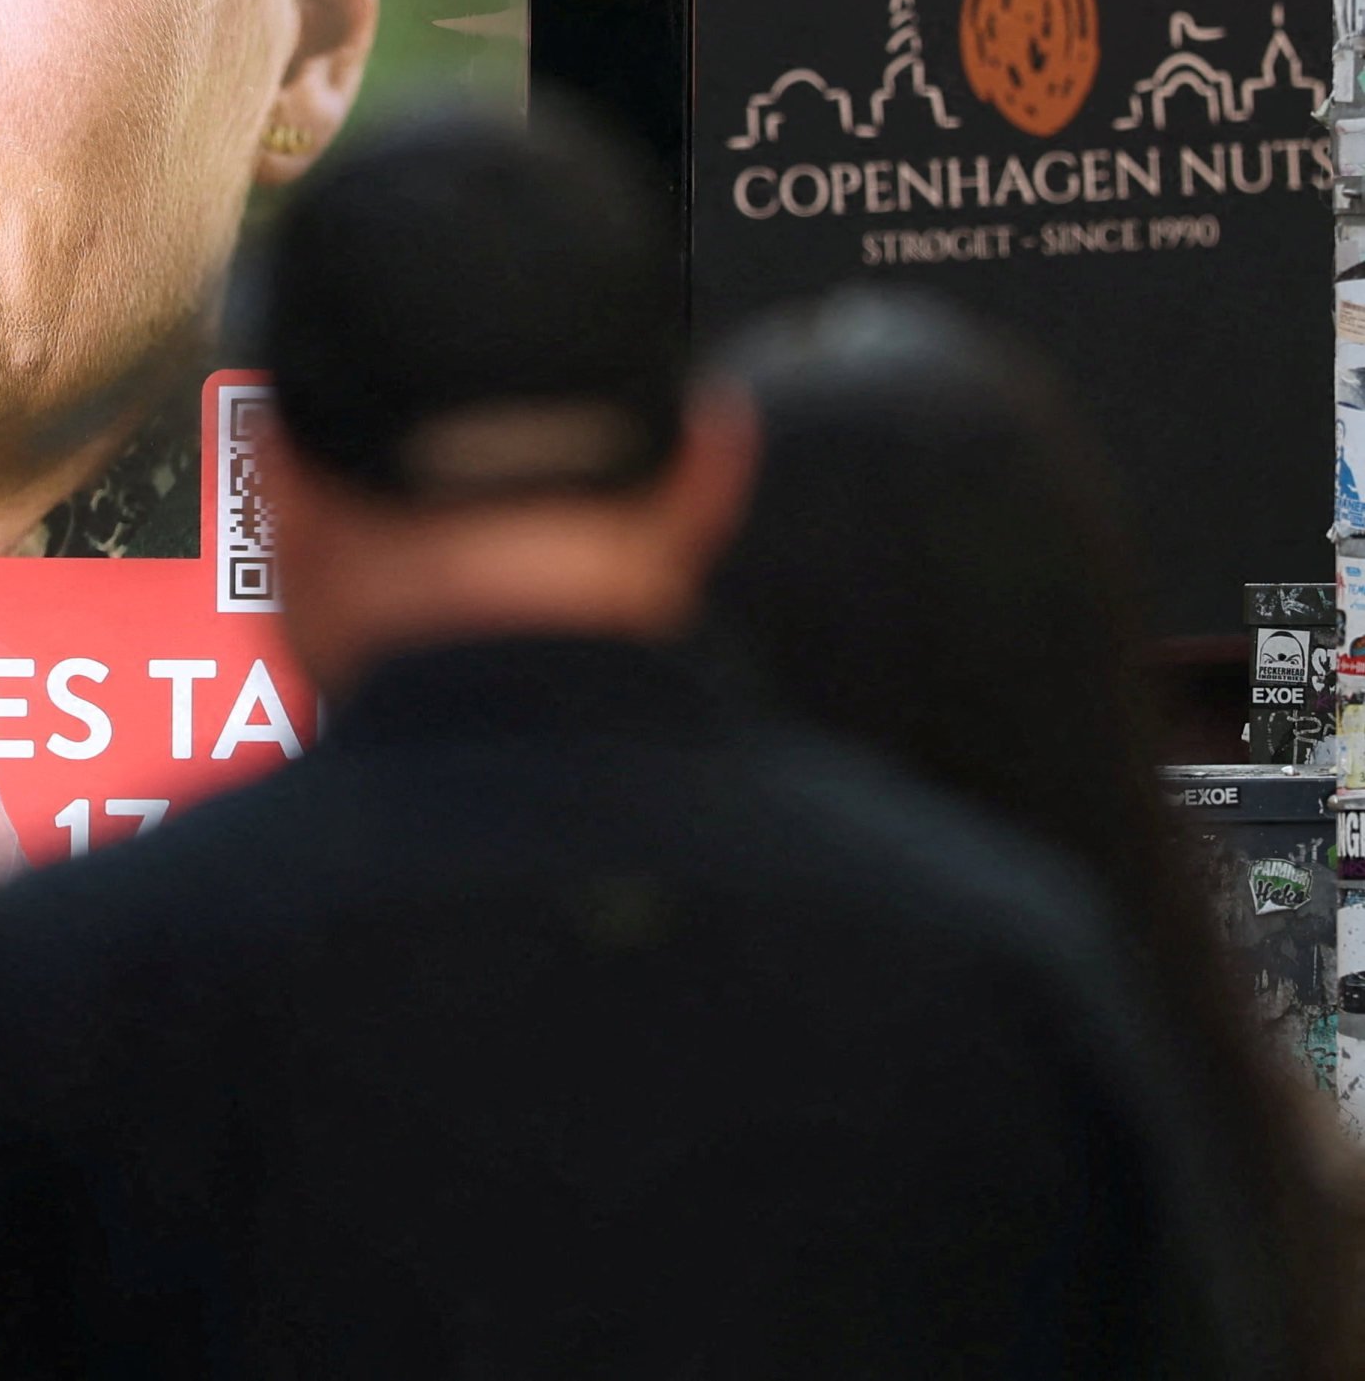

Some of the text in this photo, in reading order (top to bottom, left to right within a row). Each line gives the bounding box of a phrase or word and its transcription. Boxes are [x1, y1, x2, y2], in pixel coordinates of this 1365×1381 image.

[732, 135, 1334, 219] COPENHAGEN NUTS
[1039, 220, 1144, 256] SINCE
[1148, 214, 1220, 250] 1990
[148, 658, 327, 760] TA
[1252, 687, 1304, 704] EXOE
[1184, 787, 1239, 806] EXOE
